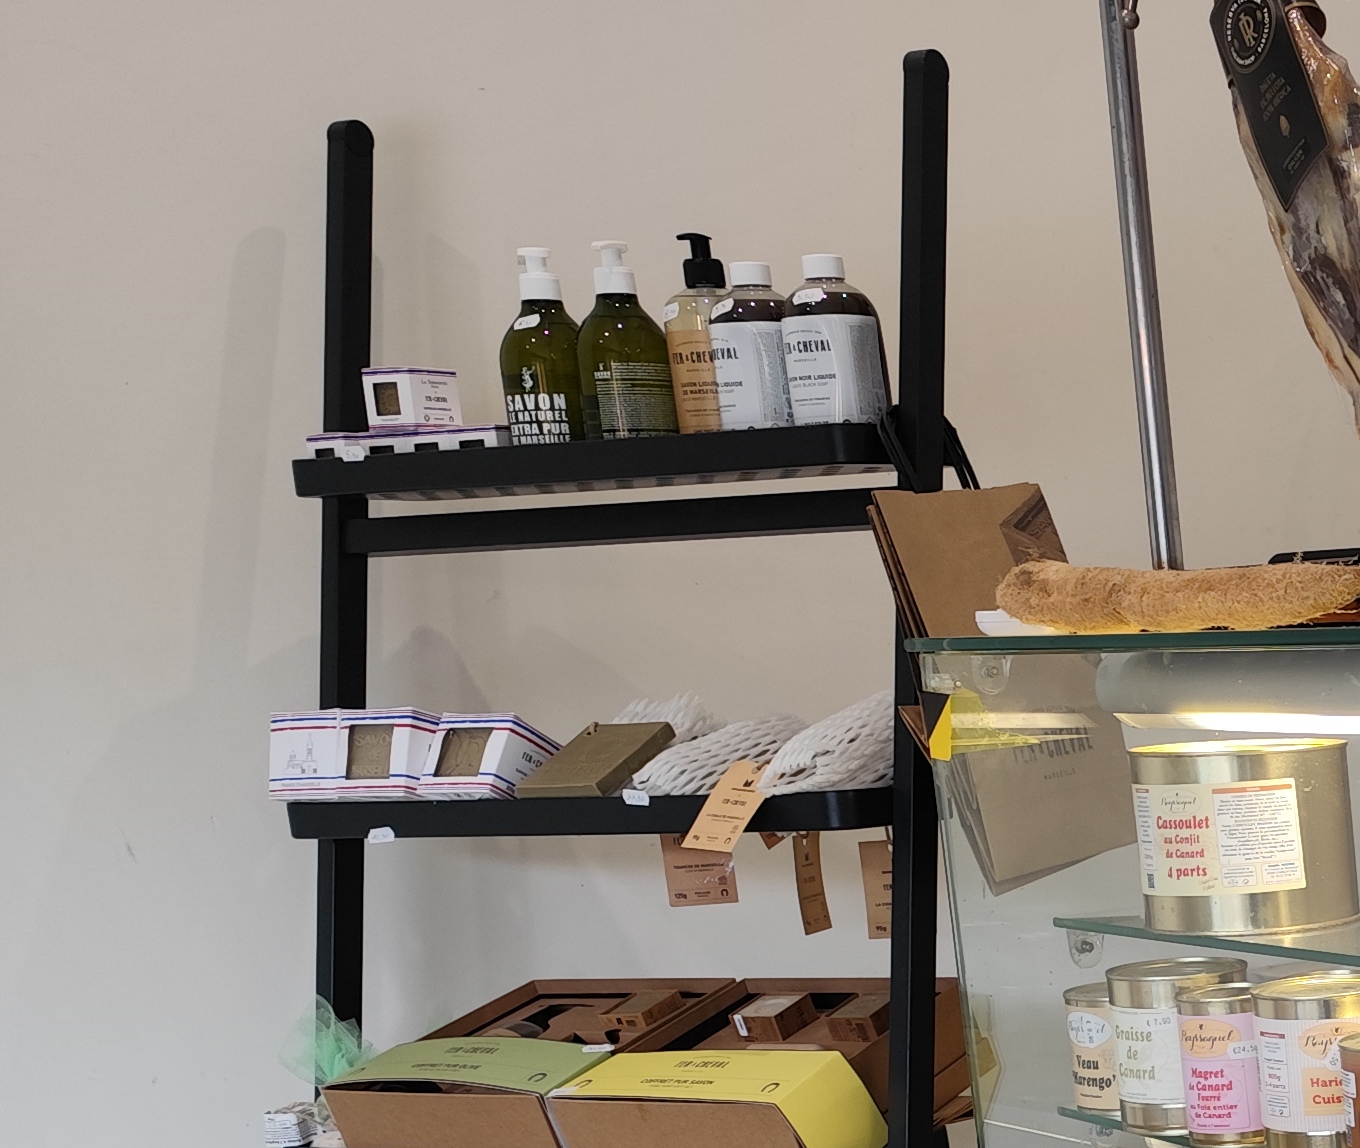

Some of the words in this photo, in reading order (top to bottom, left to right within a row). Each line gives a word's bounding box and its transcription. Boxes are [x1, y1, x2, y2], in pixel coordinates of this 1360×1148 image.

[797, 339, 832, 353] CHEVAL
[506, 393, 567, 411] SAVON
[509, 412, 516, 422] LE
[518, 410, 568, 421] NATUREL
[511, 424, 540, 436] EXTRA
[543, 422, 570, 434] PUR
[353, 734, 391, 746] SAVO
[1156, 815, 1210, 830] Cassoulet
[1163, 836, 1173, 844] au
[1174, 834, 1200, 846] Confit
[1165, 849, 1174, 859] de
[1175, 848, 1205, 859] Canard
[1167, 866, 1173, 879] 4
[1176, 864, 1208, 880] parts
[1115, 1024, 1153, 1042] Graisse
[1126, 1045, 1139, 1060] de
[1075, 1054, 1100, 1071] Veau
[1119, 1063, 1156, 1081] Canard
[1190, 1067, 1225, 1081] Magret
[1196, 1080, 1233, 1091] Canard
[1312, 1094, 1343, 1105] Cuis
